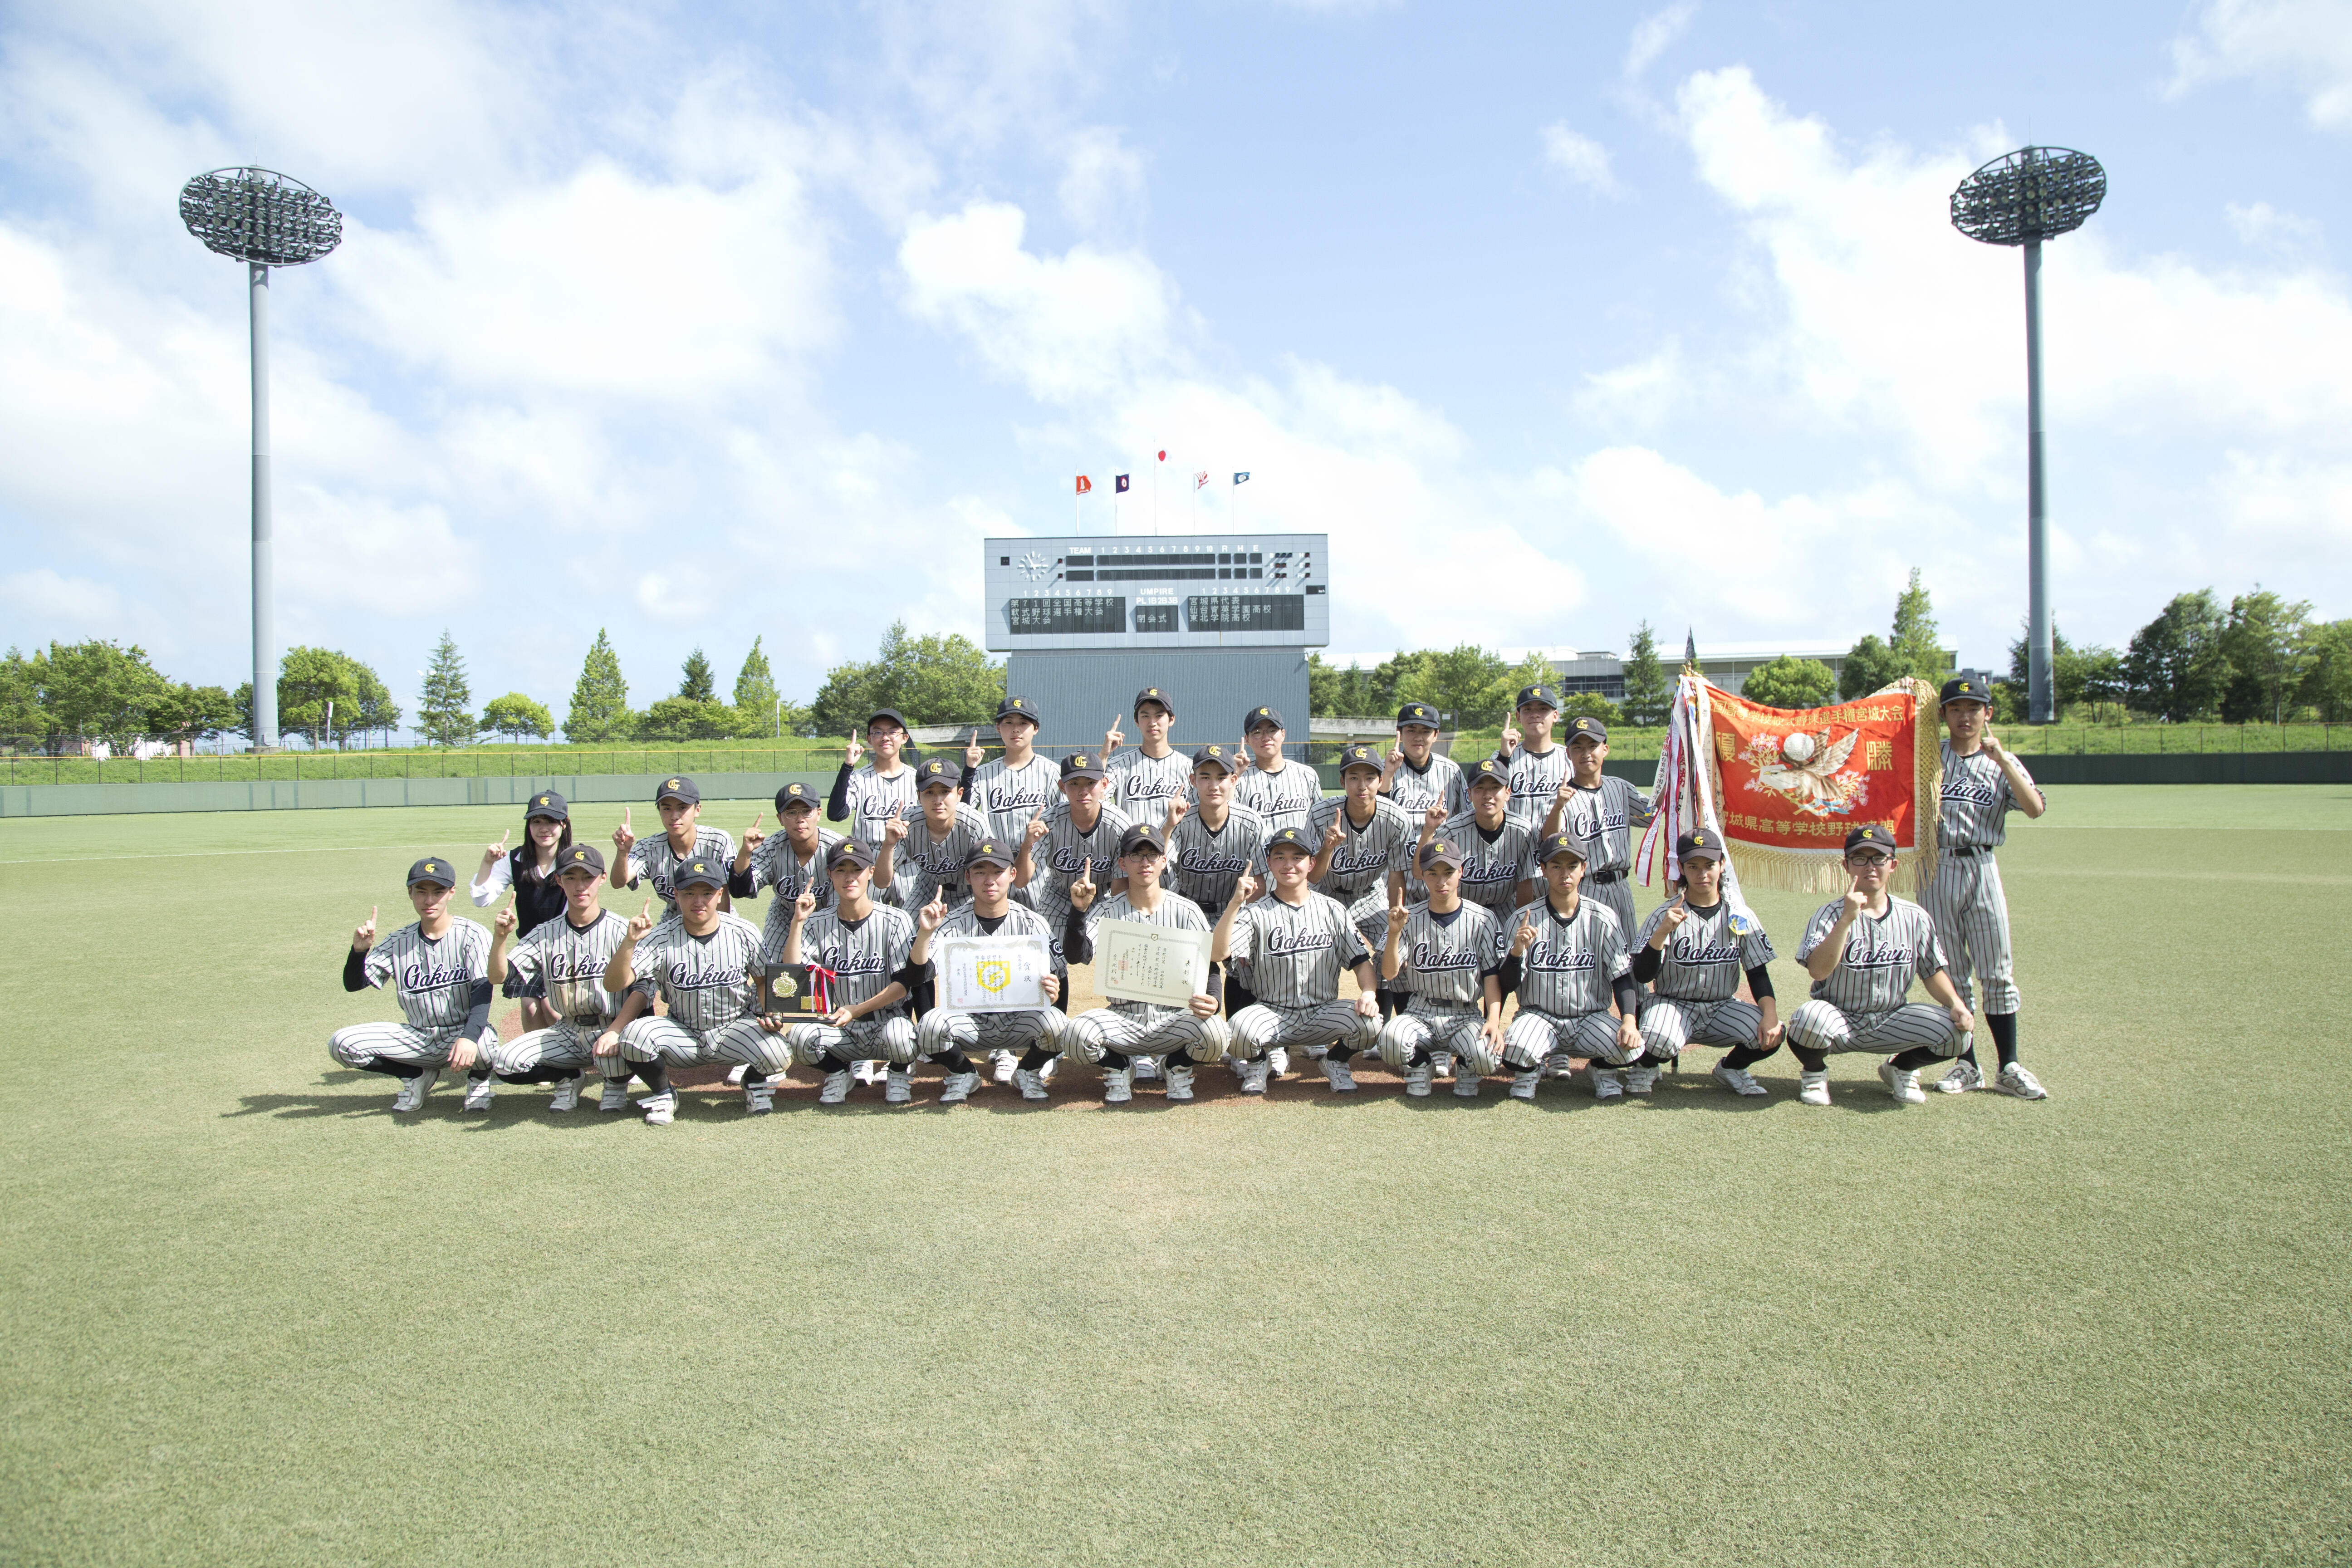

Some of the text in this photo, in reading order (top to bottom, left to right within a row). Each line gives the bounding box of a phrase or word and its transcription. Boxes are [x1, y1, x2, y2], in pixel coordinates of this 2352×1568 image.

[1011, 608, 1104, 616] 軟式野球選手権大会
[1189, 596, 1240, 605] 宮城県代表
[1190, 605, 1271, 614] 仙台育英学園高校
[1011, 617, 1051, 625] 宮城大会
[1137, 613, 1167, 623] 閉会式
[1190, 613, 1250, 622] 東北学院高校
[1710, 698, 1903, 726] 国高等学校軟式野球選手権宮城大会
[1715, 731, 1735, 763] 優
[1866, 741, 1892, 771] 勝
[989, 786, 1047, 810] Gakuin
[1248, 791, 1307, 813] Gakuin
[1392, 786, 1447, 809] Gakun
[1940, 777, 1994, 805] akuin
[1180, 846, 1245, 872] Gakuin
[1267, 924, 1333, 954] Gakuin
[1672, 934, 1740, 964] Gakuin
[1844, 936, 1913, 966] Gakuin
[822, 945, 886, 974] Gakuin
[1413, 939, 1478, 969] Gakuin
[1530, 939, 1595, 969] Gakuin
[403, 962, 470, 990] Gakuin
[668, 959, 741, 988] Gakuin
[1024, 961, 1032, 982] 賞状
